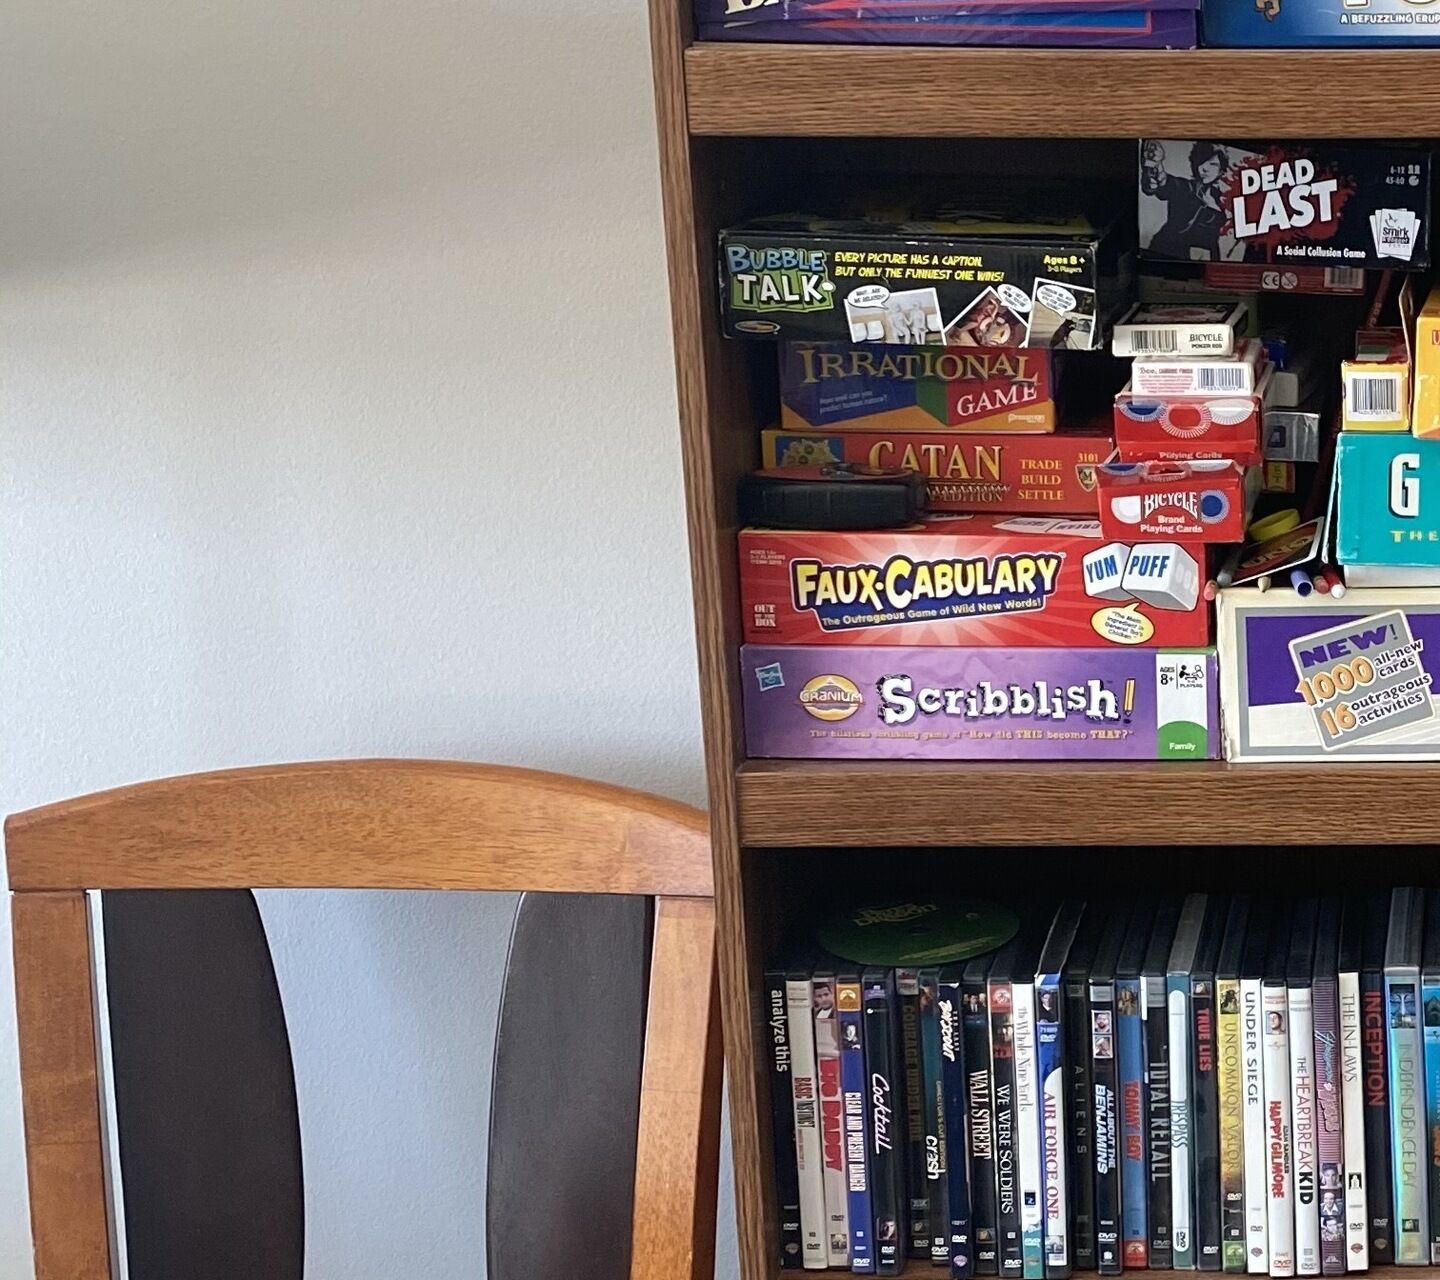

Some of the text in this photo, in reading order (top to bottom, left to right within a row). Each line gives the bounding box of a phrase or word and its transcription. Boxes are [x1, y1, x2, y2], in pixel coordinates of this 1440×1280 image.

[1241, 159, 1315, 196] DEAD
[1233, 179, 1337, 238] LAST
[726, 245, 825, 274] BUBBLE
[736, 273, 823, 303] TALK
[956, 383, 1037, 417] GAME
[869, 441, 1002, 480] CATAN
[1019, 458, 1062, 471] TRADE
[1017, 489, 1064, 502] SETTLE
[1021, 473, 1061, 486] BUILD
[1144, 491, 1198, 519] BICYCLE
[1390, 531, 1439, 543] THE
[1085, 553, 1170, 582] YUM PUFF
[1299, 623, 1399, 668] NEW!
[1374, 640, 1423, 666] all-new
[1160, 673, 1174, 686] 8+
[1298, 659, 1377, 708] 1,000
[1379, 657, 1415, 677] cards
[1350, 673, 1431, 711] outrageous
[1356, 692, 1423, 725] activities
[1321, 703, 1356, 738] 16
[1168, 741, 1196, 752] Family
[769, 990, 790, 1071] analyze this
[1196, 1008, 1212, 1071] TRUE LIES
[1245, 992, 1258, 1105] UNDER SIEGE
[1364, 991, 1385, 1106] INCEPTION
[969, 1070, 991, 1159] WALL STREET
[845, 1092, 865, 1191] CLEAR AND PRESENT DANGER
[997, 1085, 1014, 1213] WE WERE SOLDIERS
[1044, 1092, 1060, 1220] AIR FORCE ONE
[1270, 1101, 1284, 1198] HAPPY GILMORE
